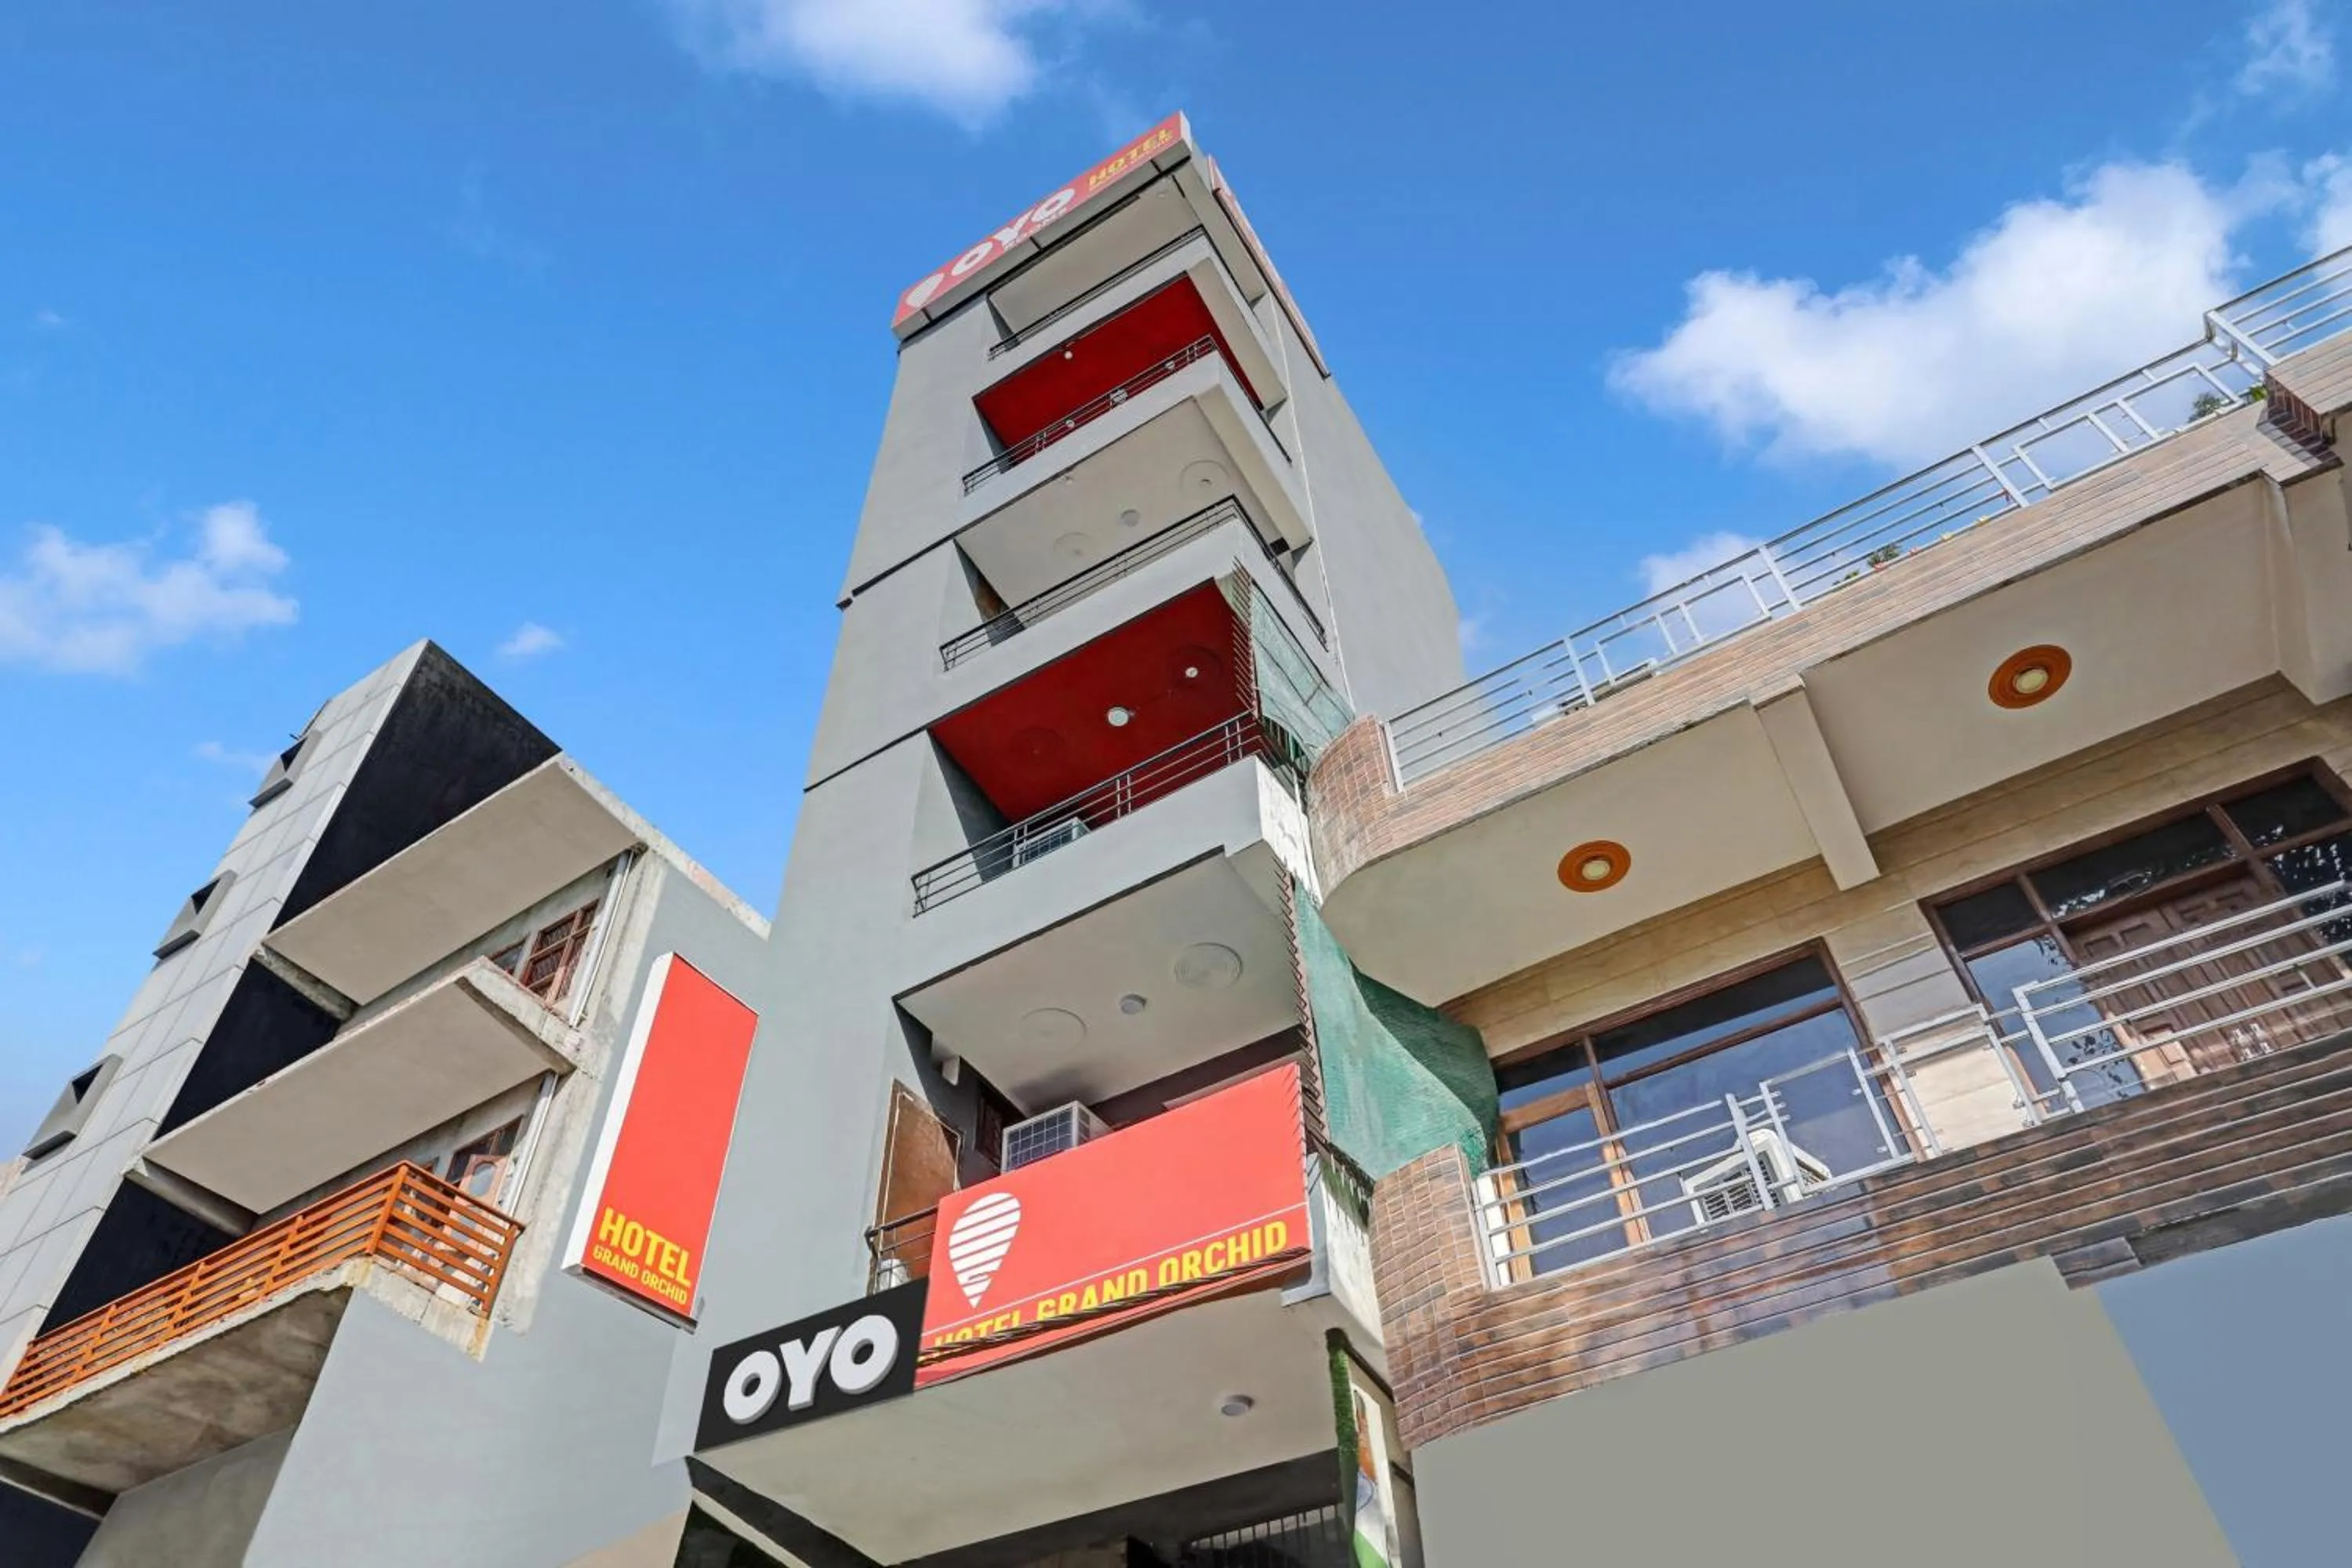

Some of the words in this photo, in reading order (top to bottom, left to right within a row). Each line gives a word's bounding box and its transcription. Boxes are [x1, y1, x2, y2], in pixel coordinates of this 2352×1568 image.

[951, 187, 1075, 276] OYO
[593, 1243, 639, 1279] GRAND
[641, 1269, 688, 1305] ORCHID
[599, 1207, 691, 1287] HOTEL
[1036, 1269, 1148, 1322] GRAND
[1158, 1221, 1287, 1287] ORCHID
[723, 1314, 899, 1425] OYO
